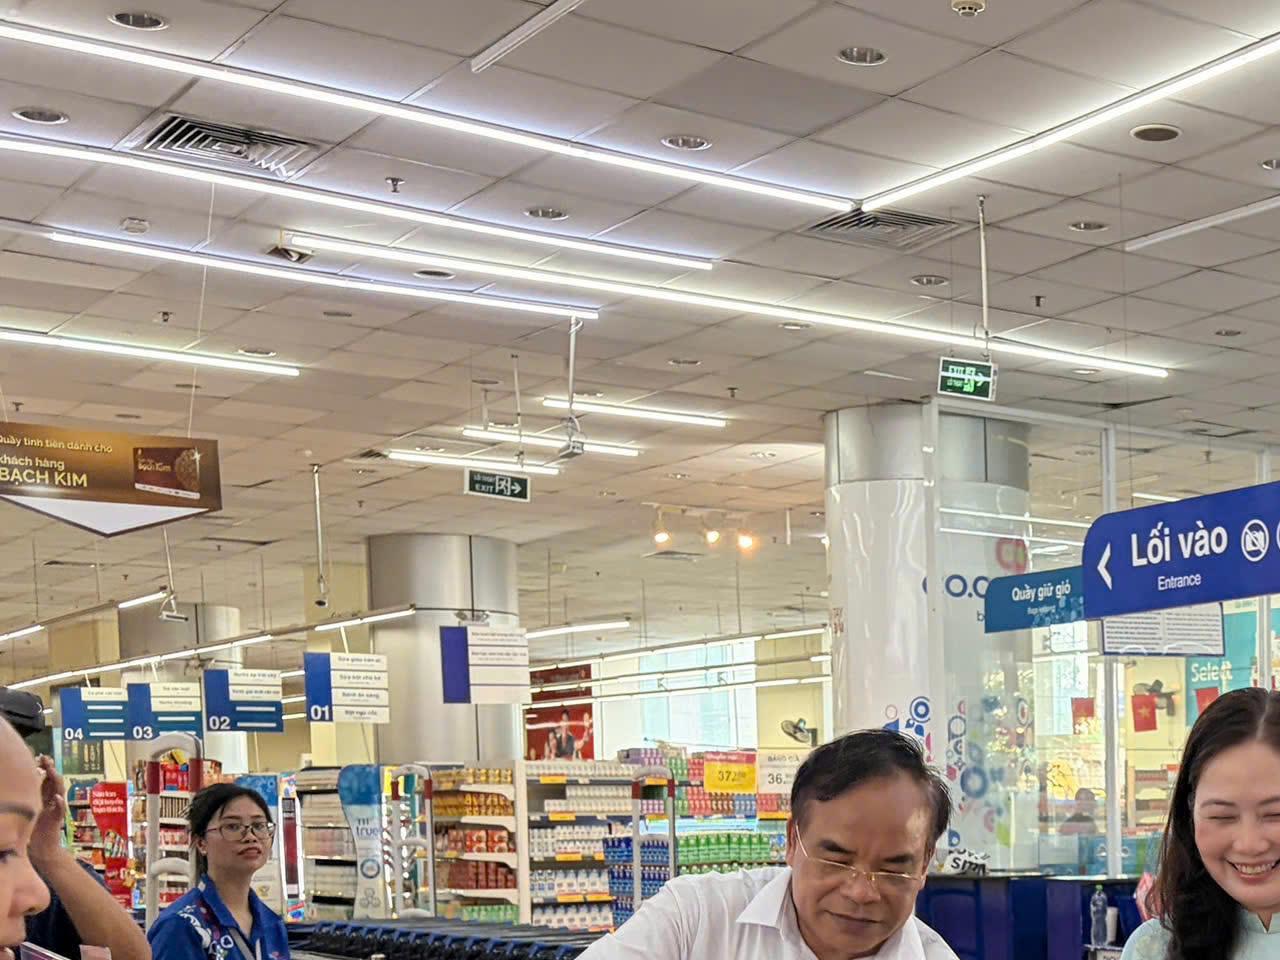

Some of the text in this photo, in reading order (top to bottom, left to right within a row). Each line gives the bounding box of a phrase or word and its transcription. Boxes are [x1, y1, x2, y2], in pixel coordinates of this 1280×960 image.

[54, 473, 88, 487] KIM
[1130, 520, 1229, 567] Lối vào
[1157, 572, 1202, 592] Entrance
[1011, 584, 1037, 602] Quầy
[1191, 661, 1233, 682] Select
[310, 704, 330, 721] 01
[209, 716, 231, 730] 02
[65, 727, 83, 740] 04
[133, 726, 153, 740] 03
